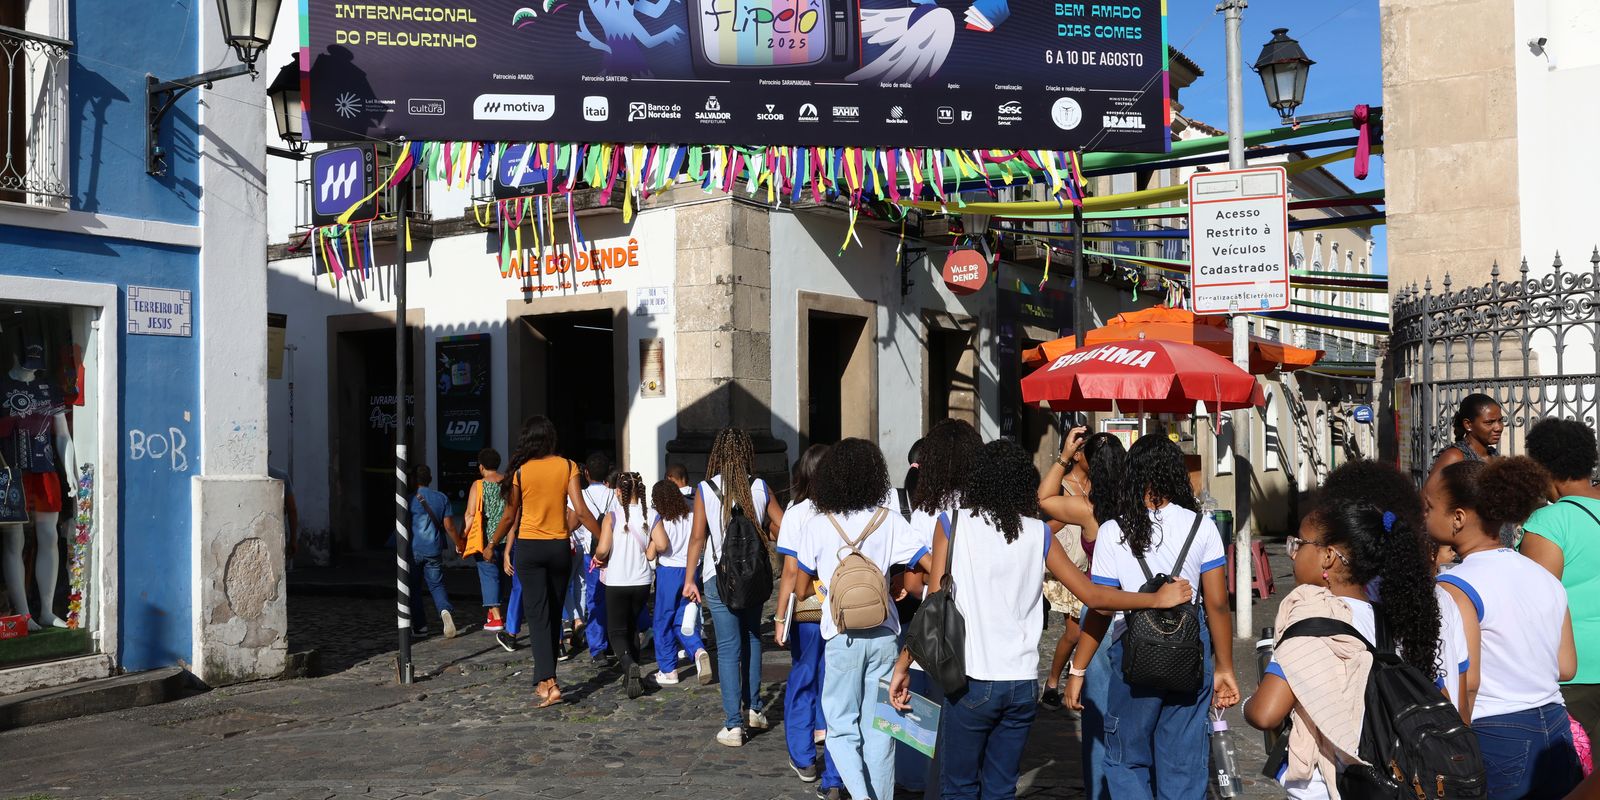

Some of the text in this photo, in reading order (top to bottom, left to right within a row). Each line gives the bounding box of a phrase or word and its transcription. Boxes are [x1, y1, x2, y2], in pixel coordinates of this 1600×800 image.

[335, 4, 477, 23] INTERNACIONAL
[1055, 3, 1142, 19] BEM AMADO
[1057, 24, 1142, 40] DIAS GOMES
[336, 30, 477, 48] DO PELOURINHO
[767, 38, 806, 49] 2025
[1045, 50, 1144, 67] 6 A 10 DE AGOSTO
[410, 104, 443, 113] cultura
[503, 102, 545, 112] motiva
[585, 106, 606, 116] itaú
[939, 109, 951, 117] TV
[998, 105, 1022, 114] Sesc
[648, 111, 681, 119] Nordeste
[695, 112, 731, 120] SALVADOR
[1103, 116, 1146, 128] BRASIL
[1215, 209, 1260, 220] Acesso
[1206, 224, 1271, 238] Restrito à
[1212, 244, 1266, 256] Veículos
[545, 253, 571, 276] DO
[575, 237, 639, 272] DENDÊ
[950, 264, 967, 273] VALE
[1200, 262, 1280, 275] Cadastrados
[952, 271, 979, 282] DENDÊ
[133, 300, 184, 315] TERREIRO DE
[147, 317, 173, 329] JESUS
[1047, 344, 1157, 372] BRAHMA
[445, 420, 480, 435] LDM
[129, 427, 189, 472] BOB
